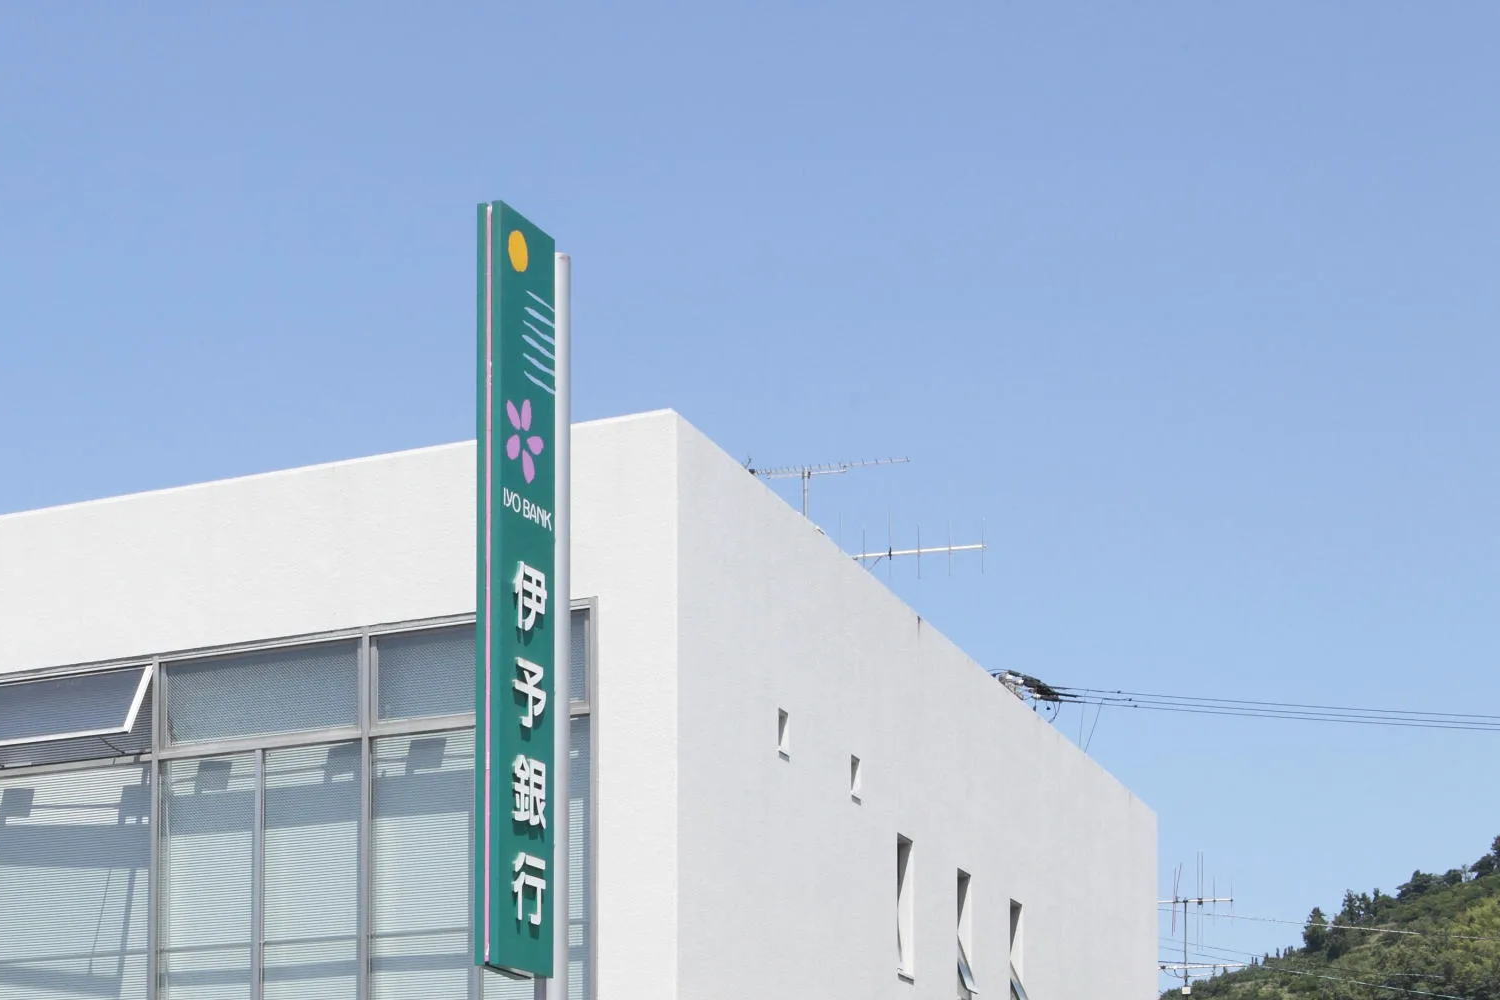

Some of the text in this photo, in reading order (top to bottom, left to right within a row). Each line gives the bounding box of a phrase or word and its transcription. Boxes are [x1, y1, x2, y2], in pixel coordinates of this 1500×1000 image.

[503, 487, 553, 532] IYO BANK
[513, 560, 548, 927] 伊予銀行
